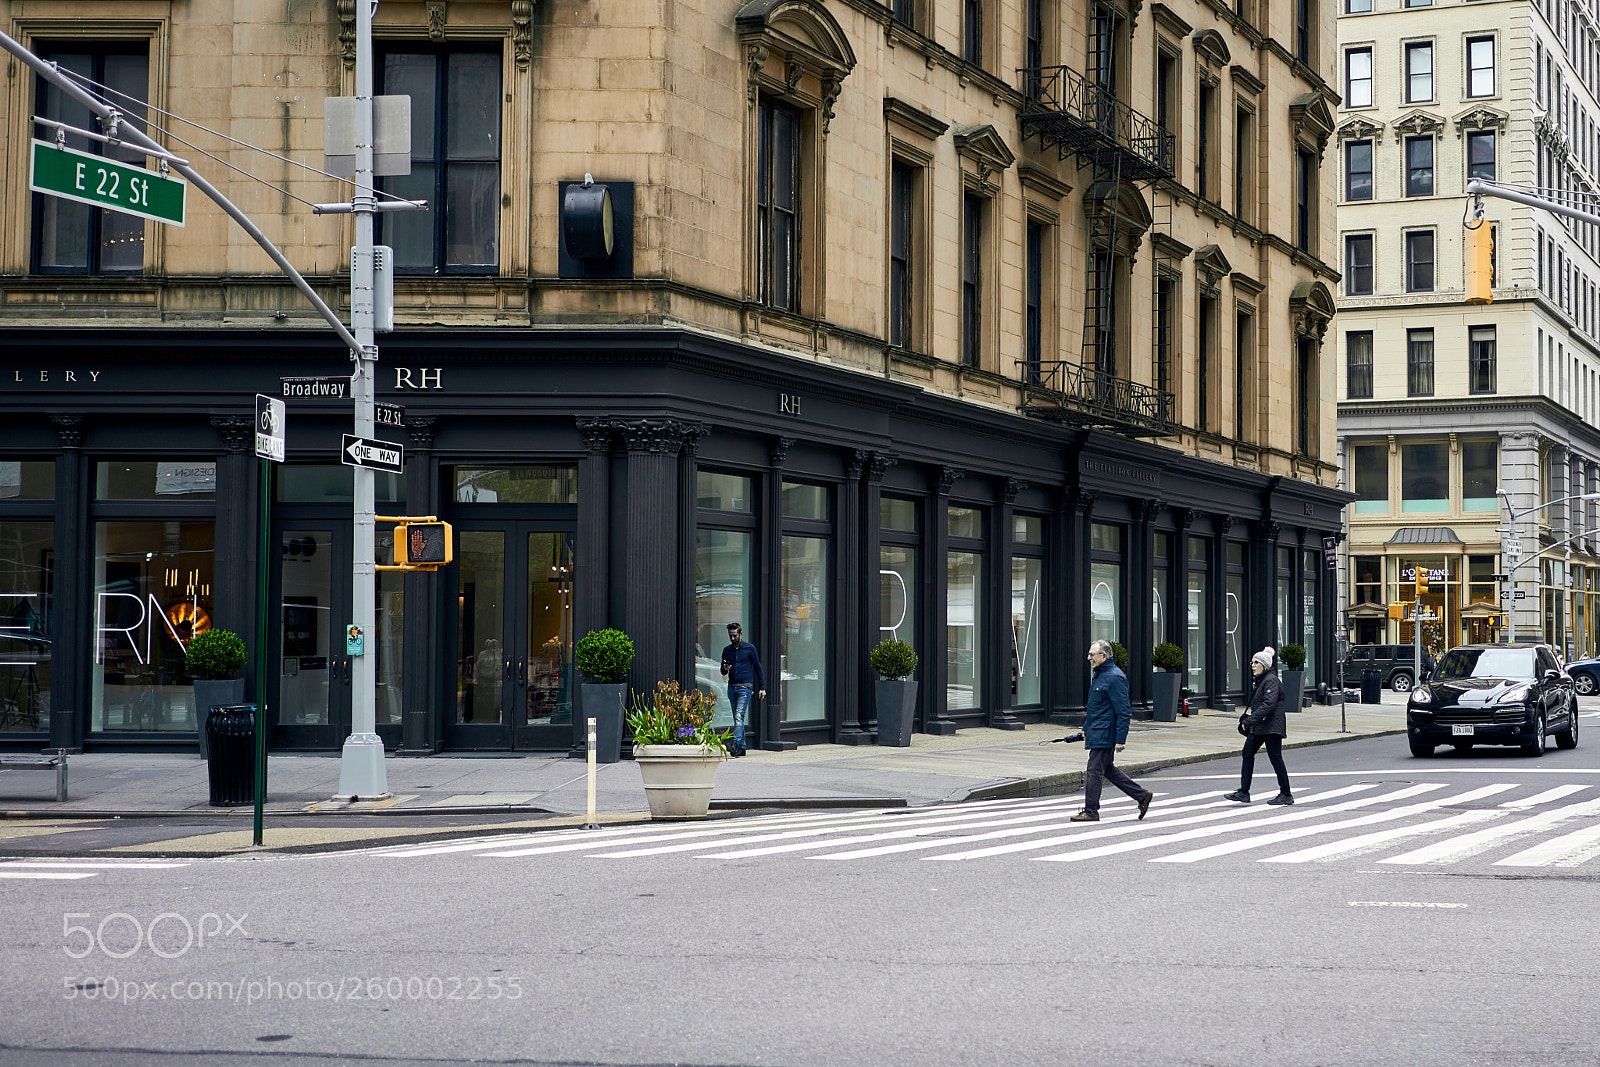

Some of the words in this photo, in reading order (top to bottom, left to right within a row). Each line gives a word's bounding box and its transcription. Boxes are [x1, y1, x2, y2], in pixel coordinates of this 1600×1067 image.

[76, 162, 86, 191] E
[96, 168, 120, 199] 22
[129, 177, 149, 206] St
[15, 370, 100, 382] LERY
[393, 367, 443, 389] RH
[283, 380, 345, 398] Broadway
[780, 393, 801, 415] RH
[377, 407, 382, 421] E
[384, 409, 391, 423] 22
[257, 435, 268, 452] BIKE
[354, 445, 372, 459] ONE
[379, 450, 397, 463] WAY
[1085, 460, 1097, 470] THE
